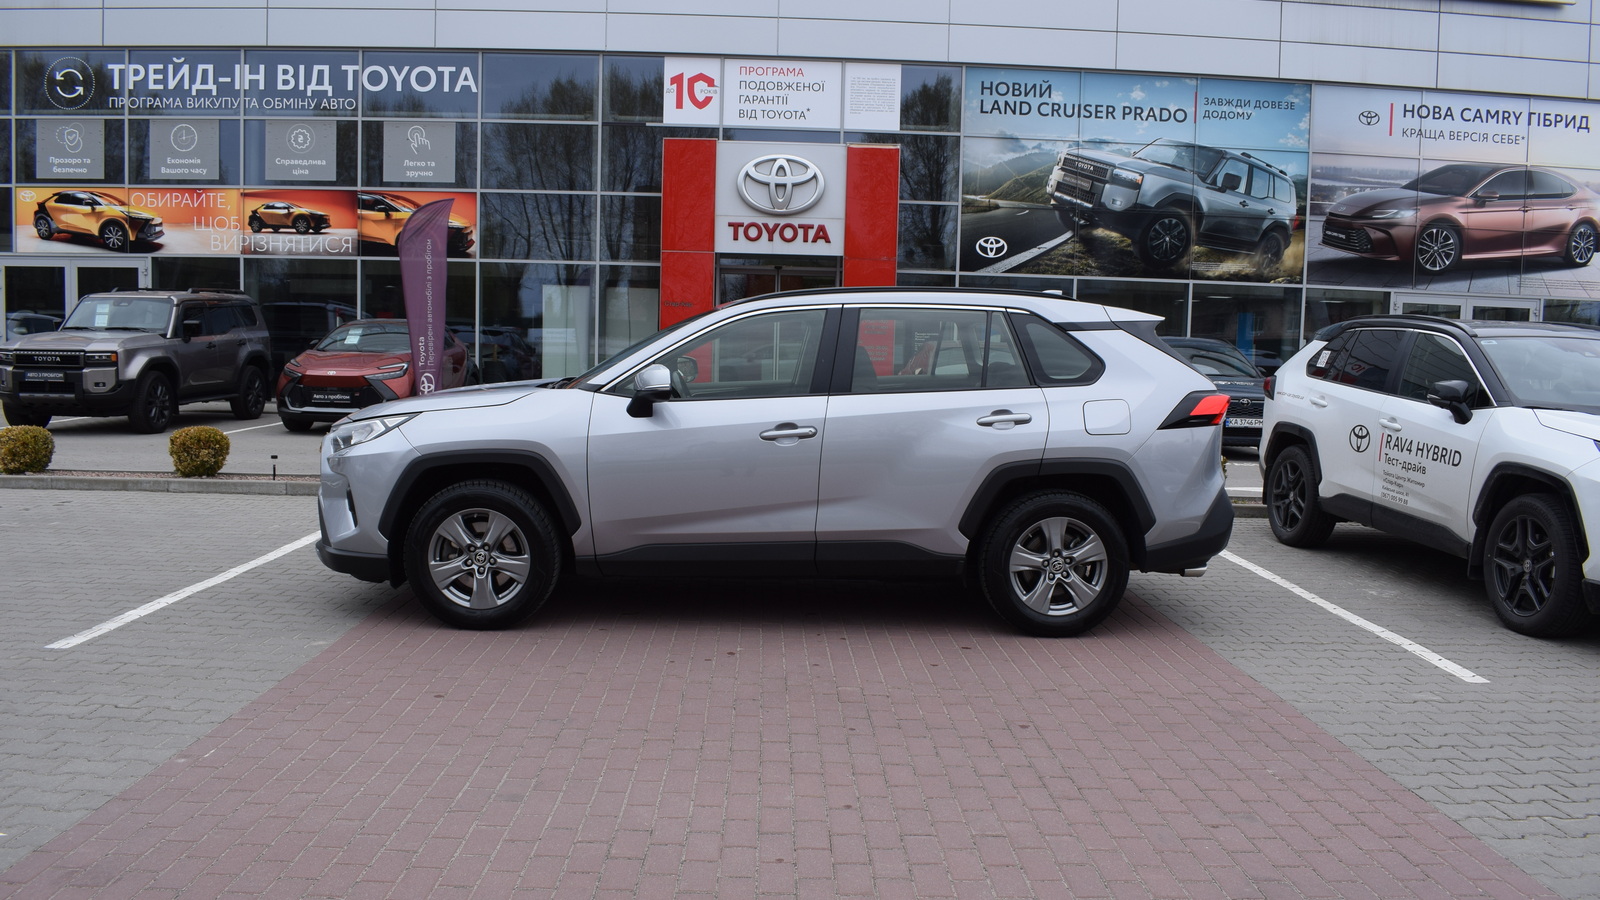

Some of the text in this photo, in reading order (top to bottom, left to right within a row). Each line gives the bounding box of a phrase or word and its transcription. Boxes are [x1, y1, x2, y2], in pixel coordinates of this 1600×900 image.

[108, 57, 478, 97] ТРЕЙД-ІН ВІД TOYOTA
[739, 66, 805, 78] ПРОГРАМА
[670, 72, 715, 110] 10
[739, 80, 826, 94] ПОДОВЖЕНОЇ
[980, 80, 1053, 99] НОВИЙ
[109, 97, 357, 111] ПРОГРАМА ВИКУПУ ТА ОБМІНУ АВТО
[739, 94, 789, 107] ГАРАНТІЇ
[1203, 97, 1296, 112] ЗАВЖДИ ДОВЕЗЕ
[739, 109, 758, 120] ВІД
[980, 99, 1188, 123] LAND CRUISER PRADO
[1203, 109, 1253, 122] ДОДОМУ
[1403, 104, 1591, 133] НОВА CAMRY ГІБРИД
[1402, 128, 1445, 142] КРАЩА
[1449, 131, 1489, 143] ВЕРСІЯ
[49, 157, 81, 166] Прозоро
[166, 157, 201, 166] Економія
[276, 158, 327, 167] Справедлива
[403, 159, 425, 168] Легко
[1075, 161, 1095, 171] TOYOTA
[52, 166, 87, 174] безпечно
[161, 167, 208, 176] Вашого часу
[292, 168, 310, 177] ціна
[405, 170, 434, 178] зручно
[131, 190, 232, 211] ОБИРАЙТЕ,
[194, 215, 240, 233] ЩОБ
[728, 222, 832, 243] TOYOTA
[210, 234, 353, 253] ВИРІЗНЯТИСЯ
[427, 324, 435, 366] Перевірені
[1385, 434, 1461, 466] RAV4 HYBRID
[1384, 453, 1426, 474] Тест-драйв
